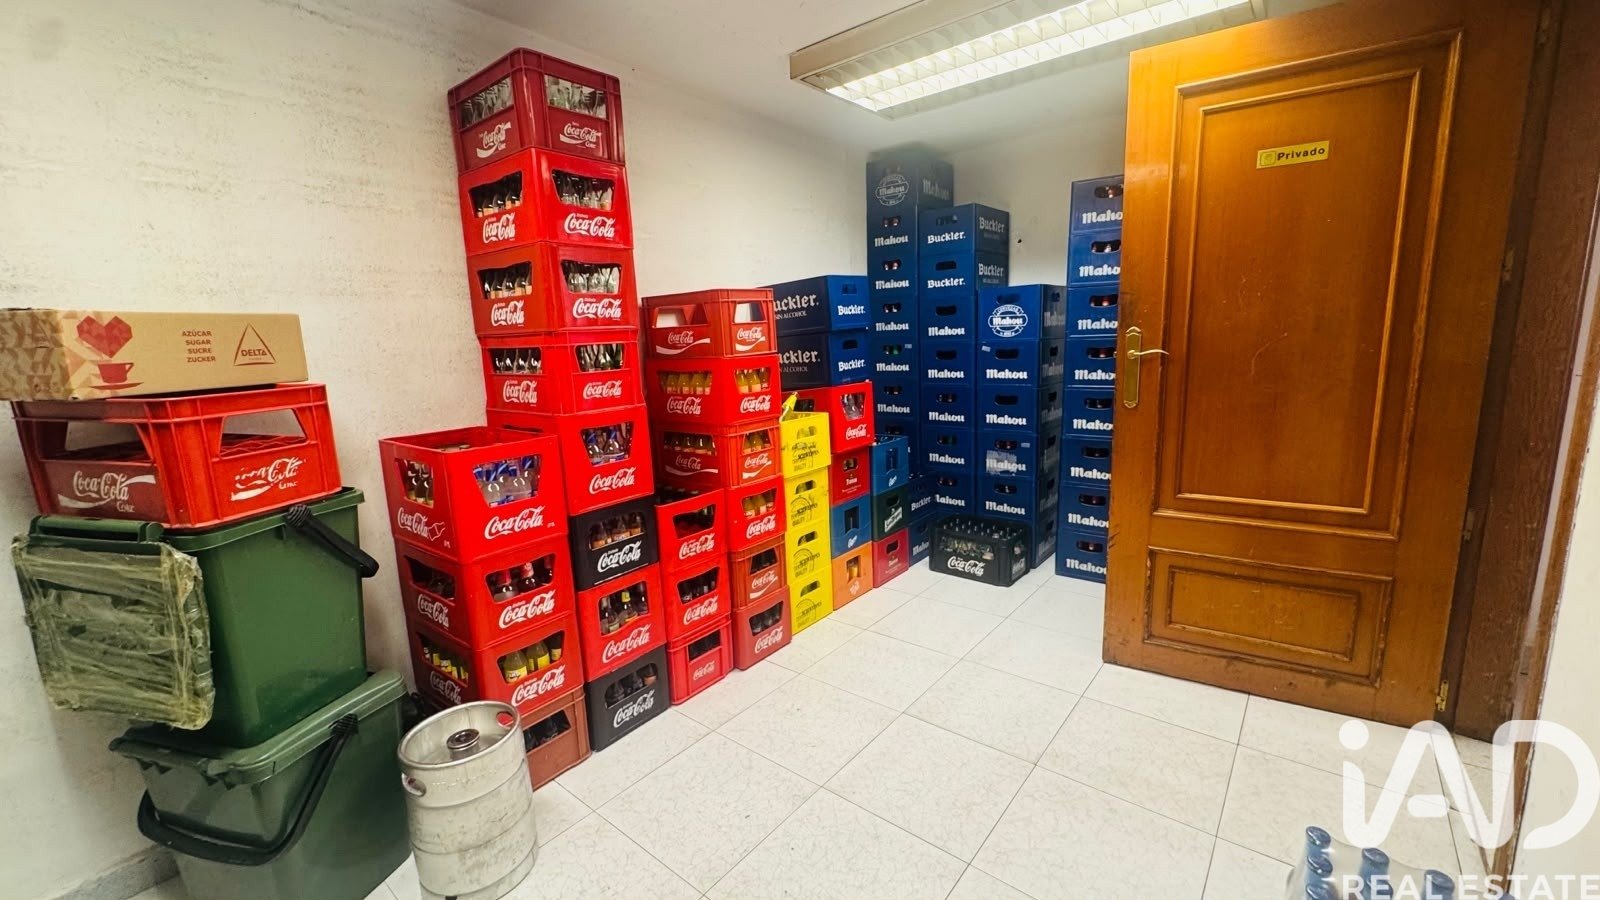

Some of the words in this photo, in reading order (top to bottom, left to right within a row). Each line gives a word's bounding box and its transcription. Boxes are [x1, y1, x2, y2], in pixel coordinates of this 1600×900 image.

[564, 123, 597, 142] Coca-Cola
[1277, 147, 1326, 161] Privado
[1082, 210, 1123, 224] Maho
[483, 212, 515, 243] Coca-Cola
[564, 213, 615, 238] Coca-Cola
[874, 235, 909, 247] Mahou
[1079, 264, 1121, 277] Maho
[875, 279, 909, 290] Mahou
[573, 298, 622, 319] Coca-Cola
[774, 294, 819, 311] uckler.
[491, 300, 525, 326] Coca-Cola
[993, 316, 1023, 325] Mahou
[876, 322, 910, 331] Mahou
[928, 326, 965, 337] Mahou
[1078, 318, 1118, 330] Maho
[182, 329, 212, 337] AZÚCAR
[668, 331, 694, 344] Coca-Cola
[737, 327, 763, 340] Coca-Cola
[241, 348, 267, 356] DELTA
[876, 363, 910, 372] Mahou
[928, 369, 965, 379] Mahou
[986, 369, 1028, 380] Mahou
[1074, 369, 1116, 380] Maho
[503, 380, 537, 403] Coca-Cola
[583, 380, 622, 399] Coca-Cola
[667, 396, 702, 415] Coca-Cola
[740, 395, 771, 413] Coca-Cola
[877, 404, 911, 414] Mahou
[928, 411, 965, 422] Mahou
[986, 414, 1027, 426] Mahou
[1073, 419, 1113, 430] Maho
[846, 424, 867, 440] Coca-Cola
[676, 455, 702, 470] Coca-Cola
[744, 453, 769, 468] Coca-Cola
[929, 453, 965, 465] Mahou
[985, 458, 1027, 471] Mahou
[73, 470, 129, 500] Coca-Cola
[589, 467, 636, 494] Coca-Cola
[985, 501, 1026, 515] Mahou
[398, 507, 429, 539] Coca-Cola
[484, 506, 545, 539] Coca-Cola
[746, 514, 775, 539] Coca-Cola
[679, 532, 715, 560] Coca-Cola
[913, 541, 929, 556] Maho
[597, 541, 642, 572] Coca-Cola
[948, 556, 985, 576] Coca-Cola
[752, 570, 776, 589] Coca-Cola
[418, 594, 449, 627] Coca-Cola
[499, 590, 556, 628] Coca-Cola
[683, 595, 718, 625] Coca-Cola
[602, 624, 651, 663] Coca-Cola
[754, 626, 783, 654] Coca-Cola
[693, 660, 715, 681] Coca-Cola
[430, 671, 461, 704] Coca-Cola
[511, 665, 565, 706] Coca-Cola
[613, 690, 654, 728] Coca-Cola
